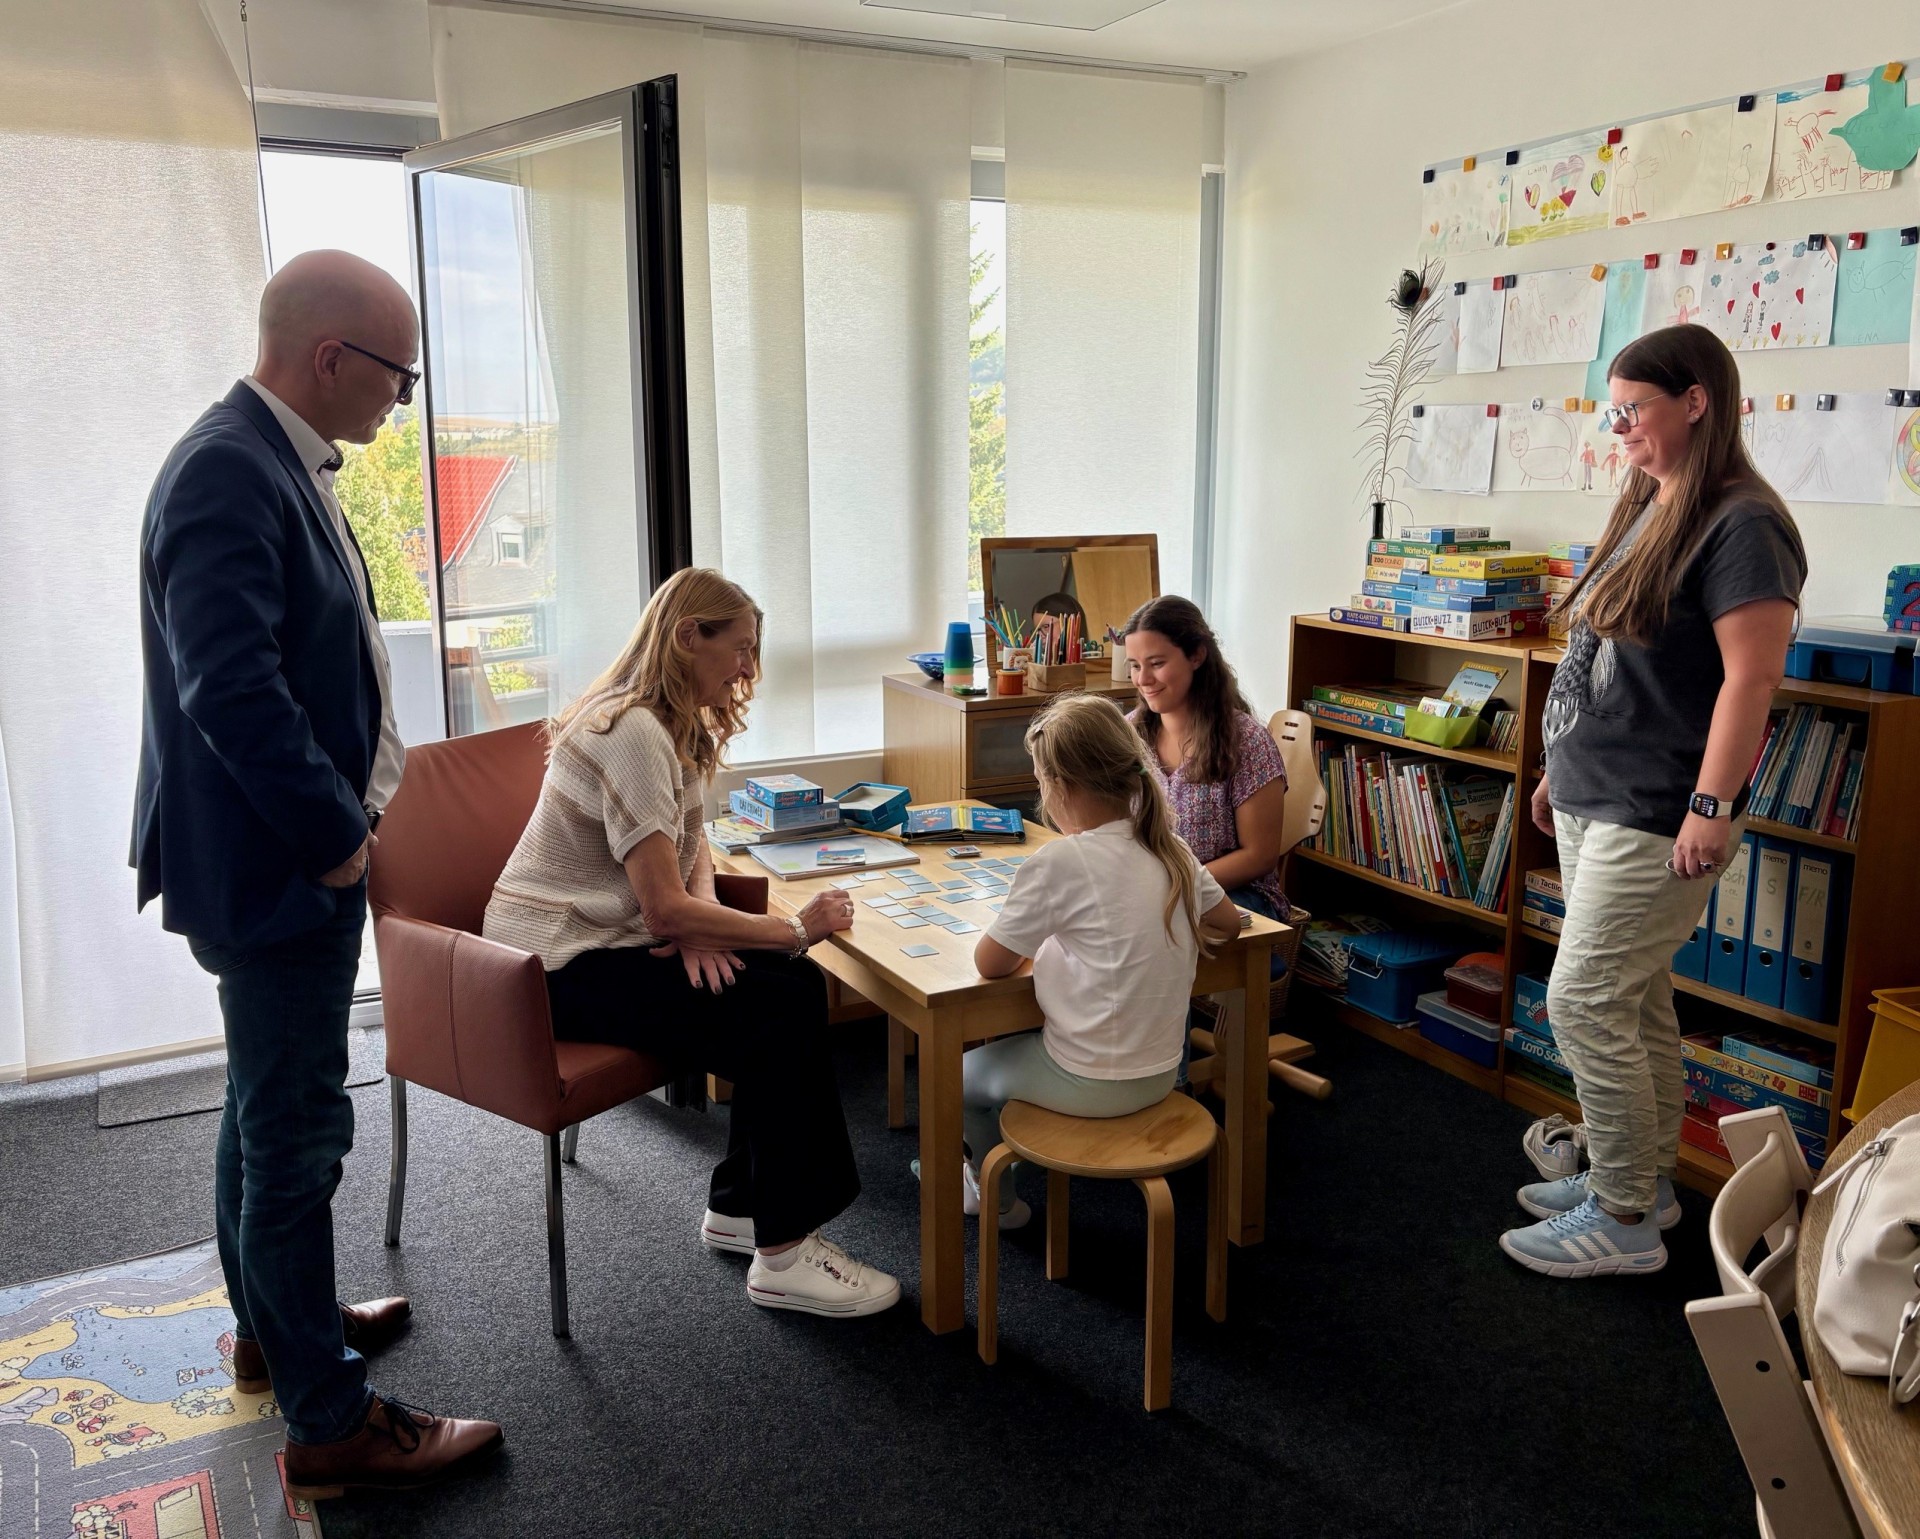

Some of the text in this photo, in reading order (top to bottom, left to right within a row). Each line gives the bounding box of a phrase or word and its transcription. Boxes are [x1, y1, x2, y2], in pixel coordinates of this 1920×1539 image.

[1501, 565, 1533, 575] Buchstaben
[1901, 581, 1920, 617] 2
[1763, 854, 1788, 865] memo
[1803, 864, 1828, 875] memo
[1540, 878, 1562, 892] Tactilo
[1766, 879, 1777, 895] S
[1521, 1040, 1544, 1058] LOTO
